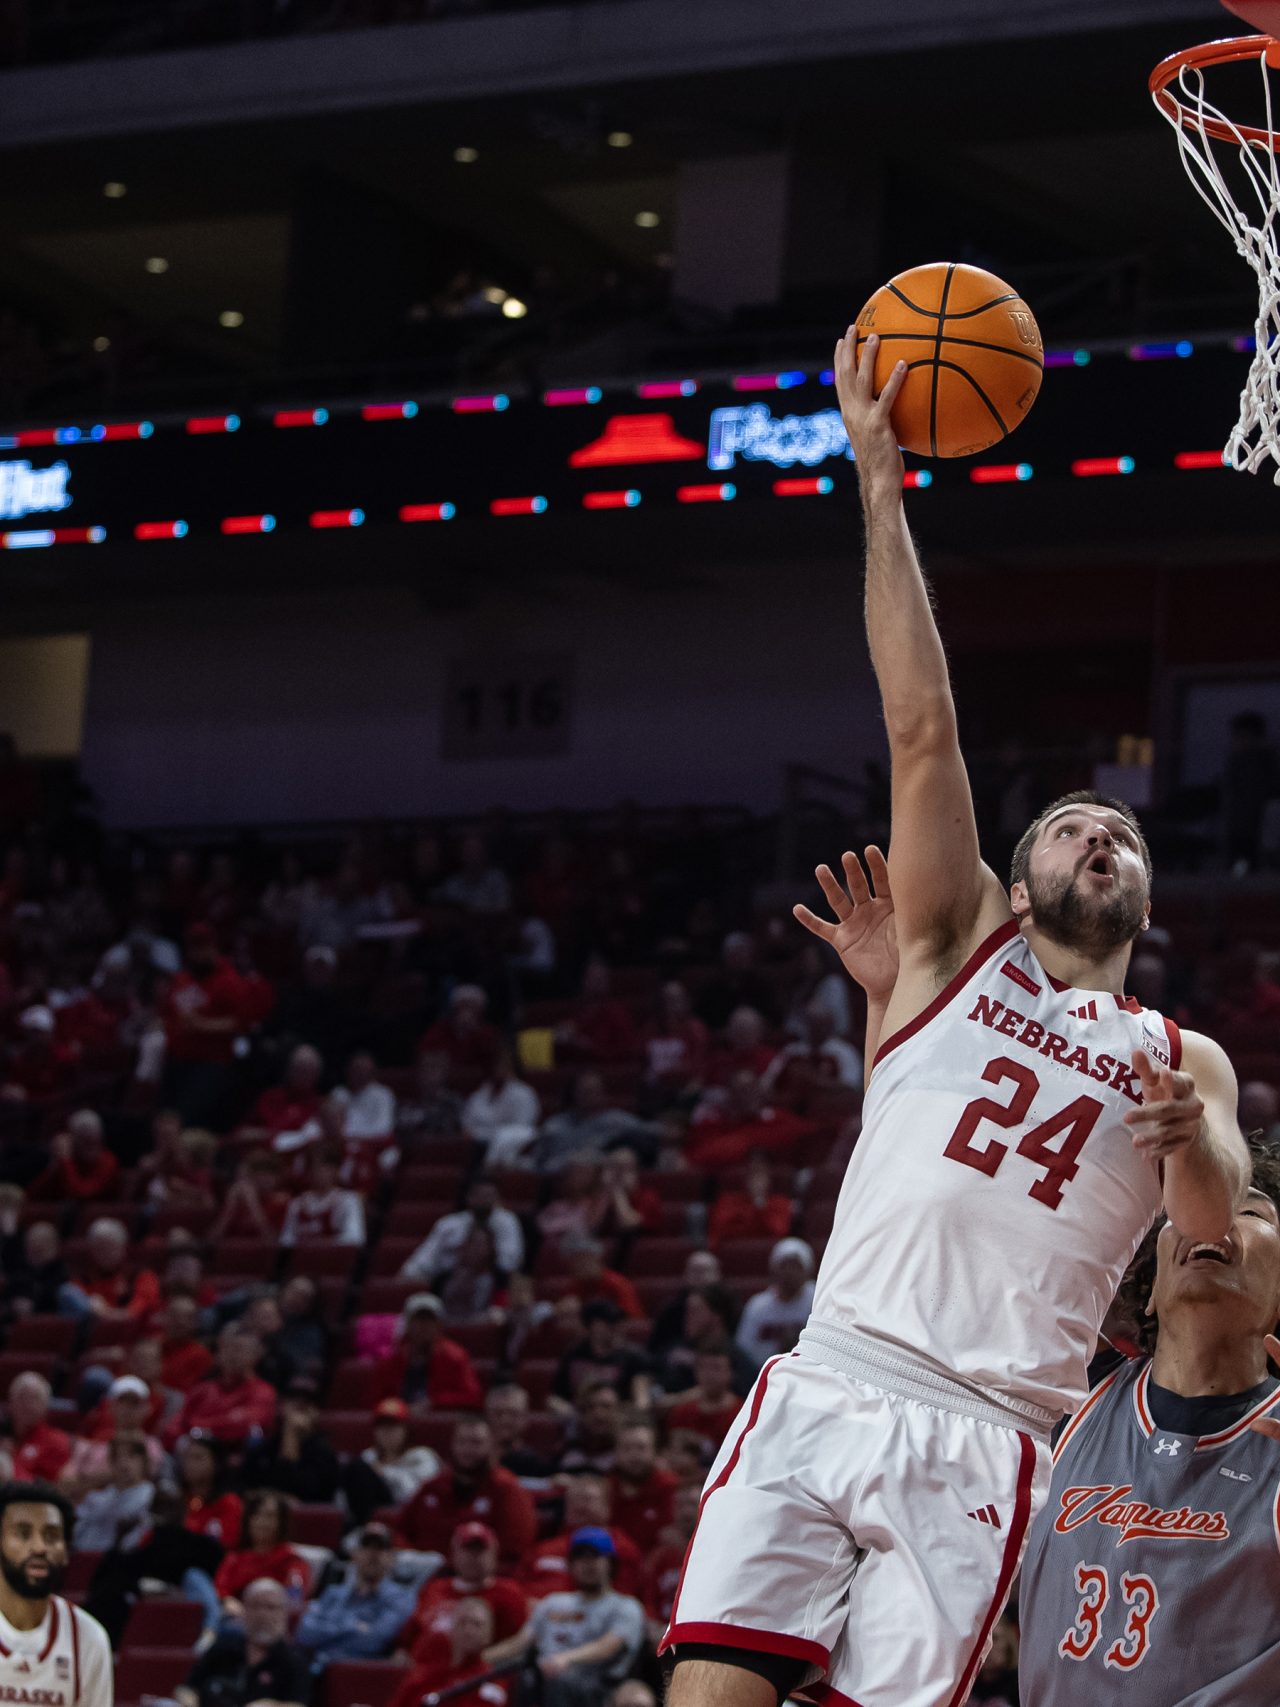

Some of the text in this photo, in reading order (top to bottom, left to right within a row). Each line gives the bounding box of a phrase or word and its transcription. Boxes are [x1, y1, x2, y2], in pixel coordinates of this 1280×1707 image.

[967, 994, 1144, 1107] NEBRASK
[943, 1056, 1105, 1211] 24
[1054, 1483, 1230, 1548] Vaqueros
[1058, 1560, 1160, 1672] 33
